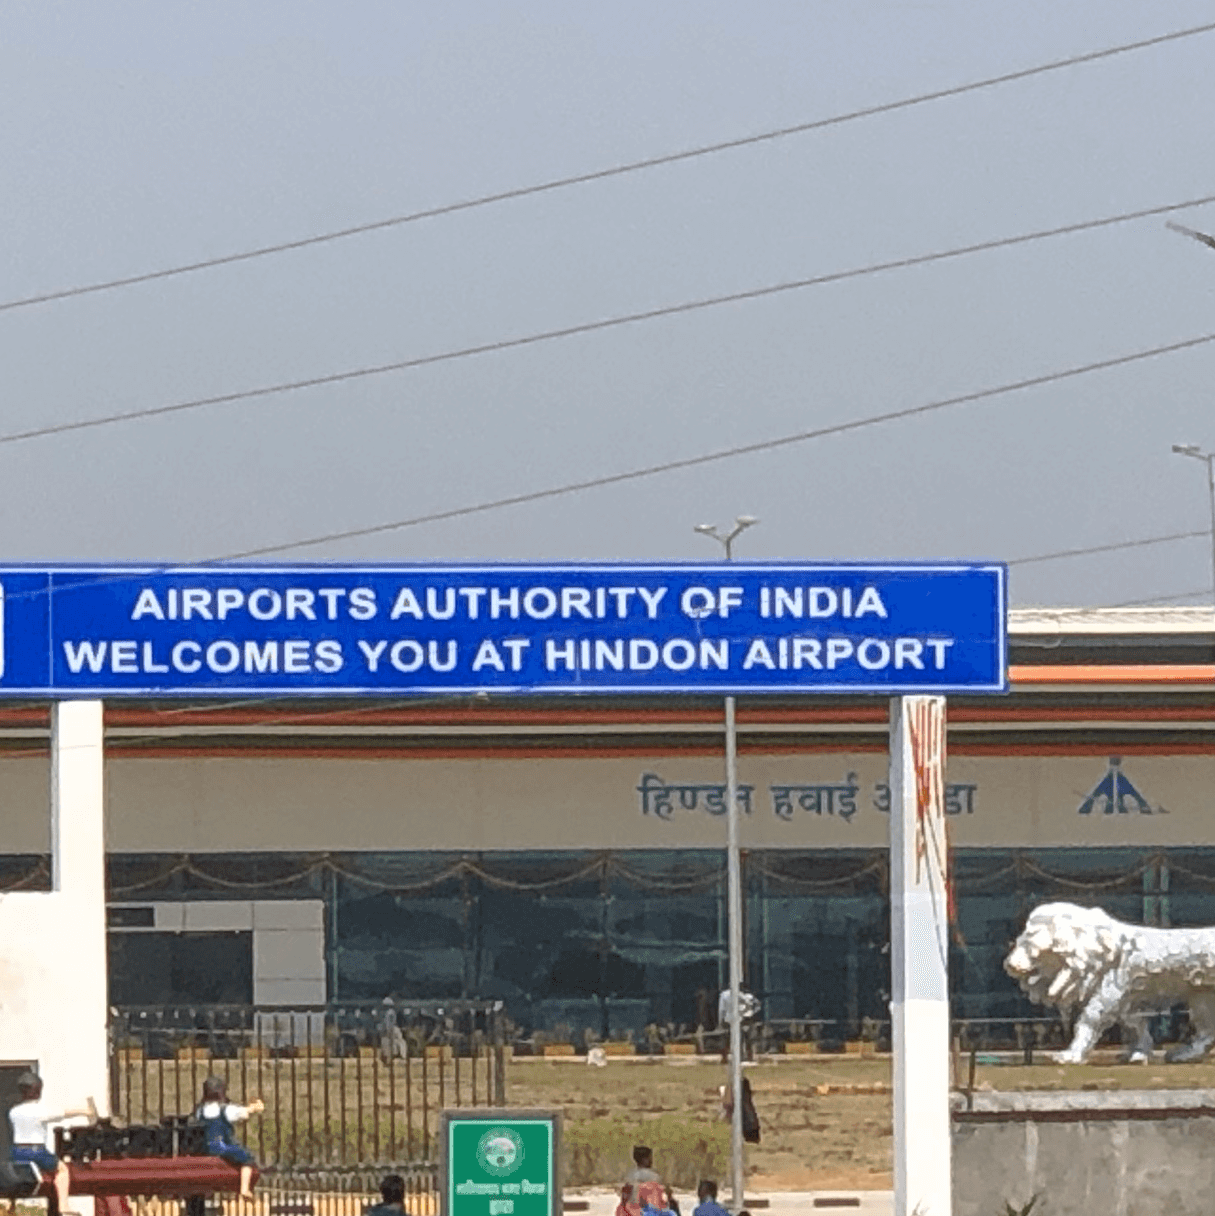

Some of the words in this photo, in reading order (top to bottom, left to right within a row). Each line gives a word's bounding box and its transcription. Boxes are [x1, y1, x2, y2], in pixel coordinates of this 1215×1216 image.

[133, 589, 376, 619] AIRPORTS
[392, 588, 666, 618] AUTHORITY
[683, 588, 742, 617] OF
[761, 588, 886, 616] INDIA
[65, 641, 342, 672] WELCOMES
[359, 641, 455, 671] YOU
[474, 640, 529, 670] AT
[547, 640, 727, 669] HINDON
[744, 639, 952, 669] AIRPORT
[771, 773, 859, 821] हवाई
